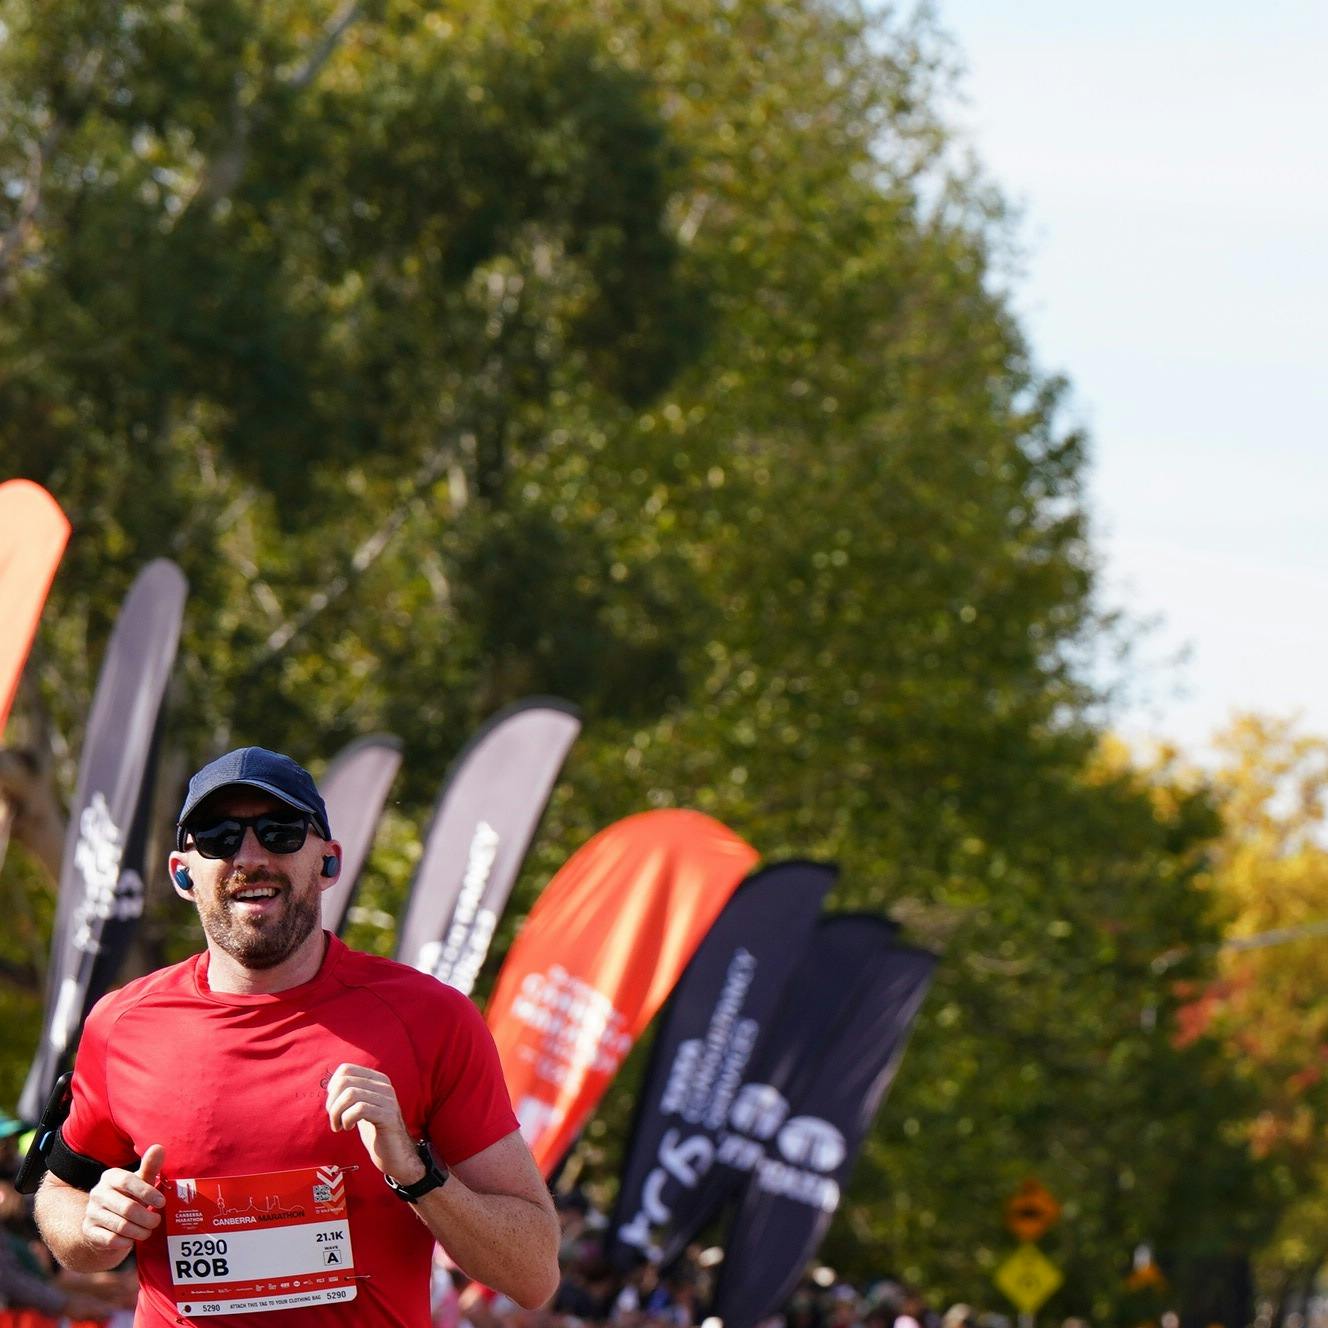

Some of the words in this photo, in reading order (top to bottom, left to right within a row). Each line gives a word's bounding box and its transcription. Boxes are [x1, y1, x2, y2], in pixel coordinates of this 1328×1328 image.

[213, 1216, 257, 1226] CANBERRA
[258, 1210, 305, 1222] MARATHON
[181, 1239, 228, 1257] 5290
[316, 1231, 344, 1242] 21.1K
[175, 1258, 229, 1279] ROB
[327, 1252, 339, 1264] A
[202, 1304, 221, 1313] 5290
[288, 1296, 311, 1304] CLOTHING
[326, 1290, 347, 1300] 5290
